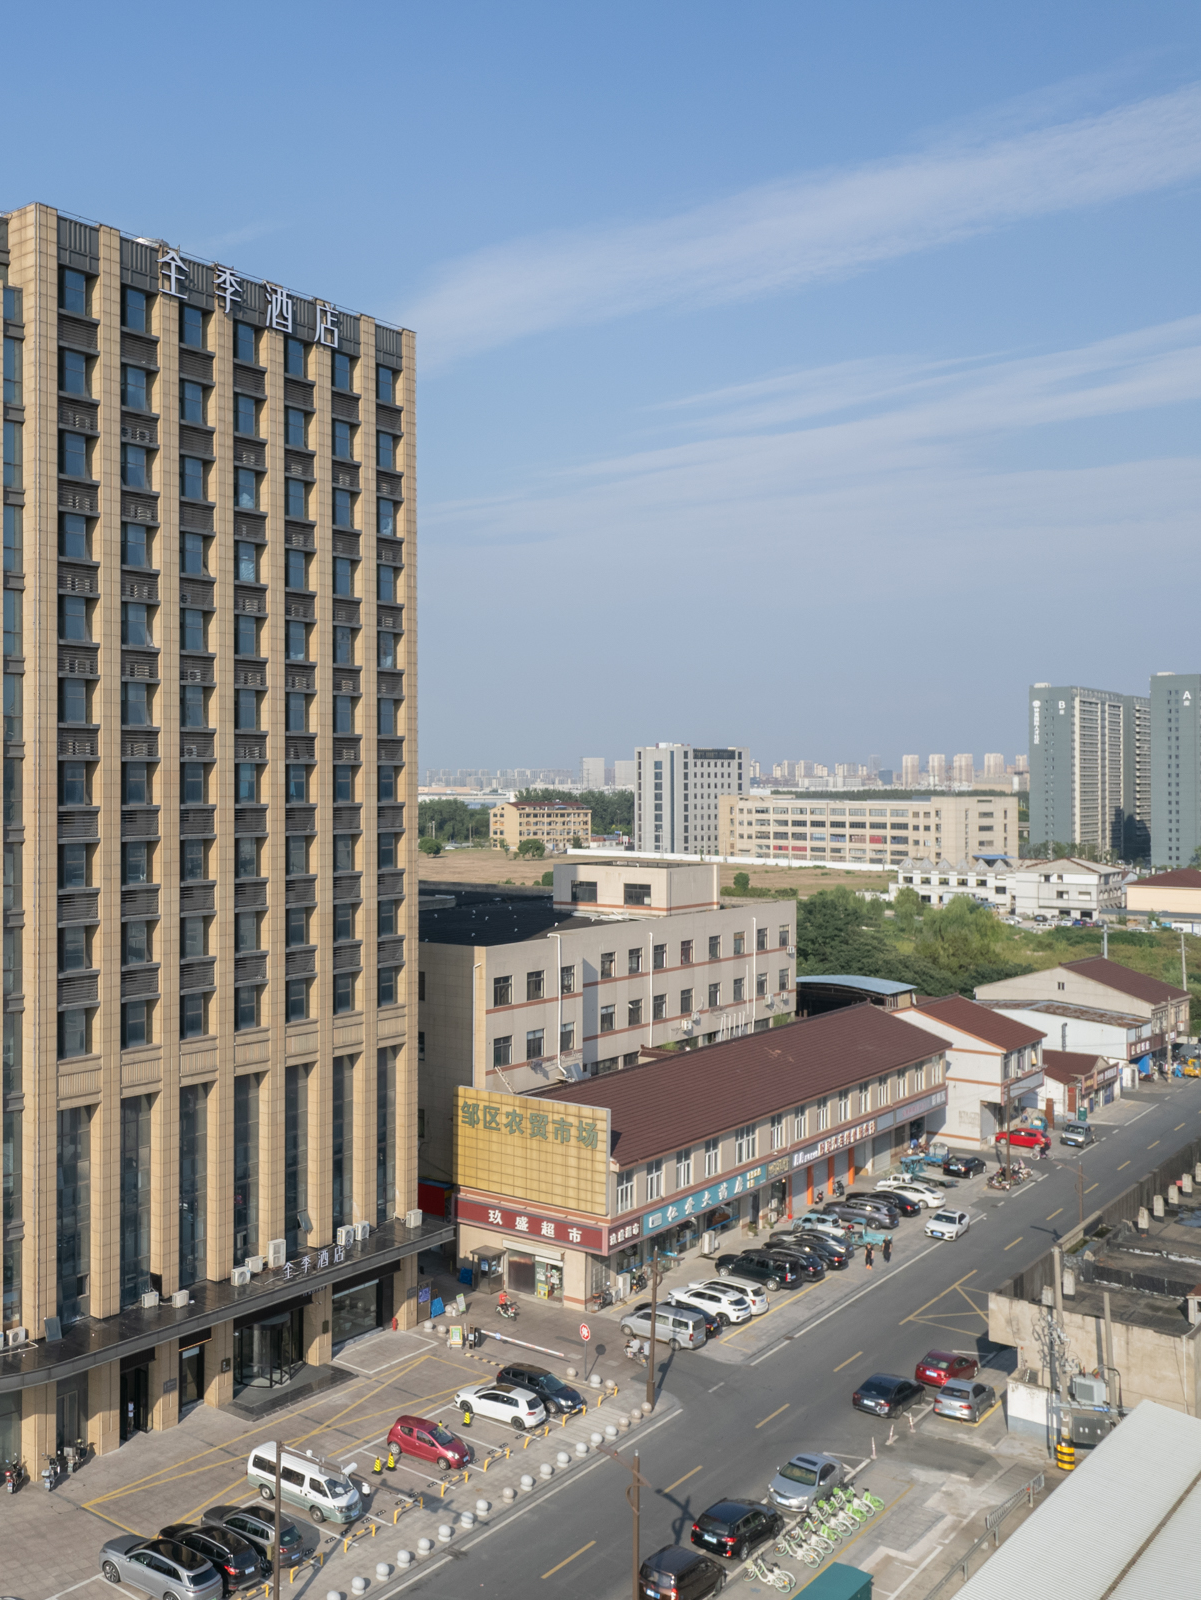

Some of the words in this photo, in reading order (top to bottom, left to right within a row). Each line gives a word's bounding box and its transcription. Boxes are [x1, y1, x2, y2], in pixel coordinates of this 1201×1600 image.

[156, 250, 339, 349] 全季酒店
[461, 1101, 599, 1149] 邹区农贸市场
[488, 1209, 582, 1243] 玖盛超市
[282, 1245, 344, 1280] 全季酒店
